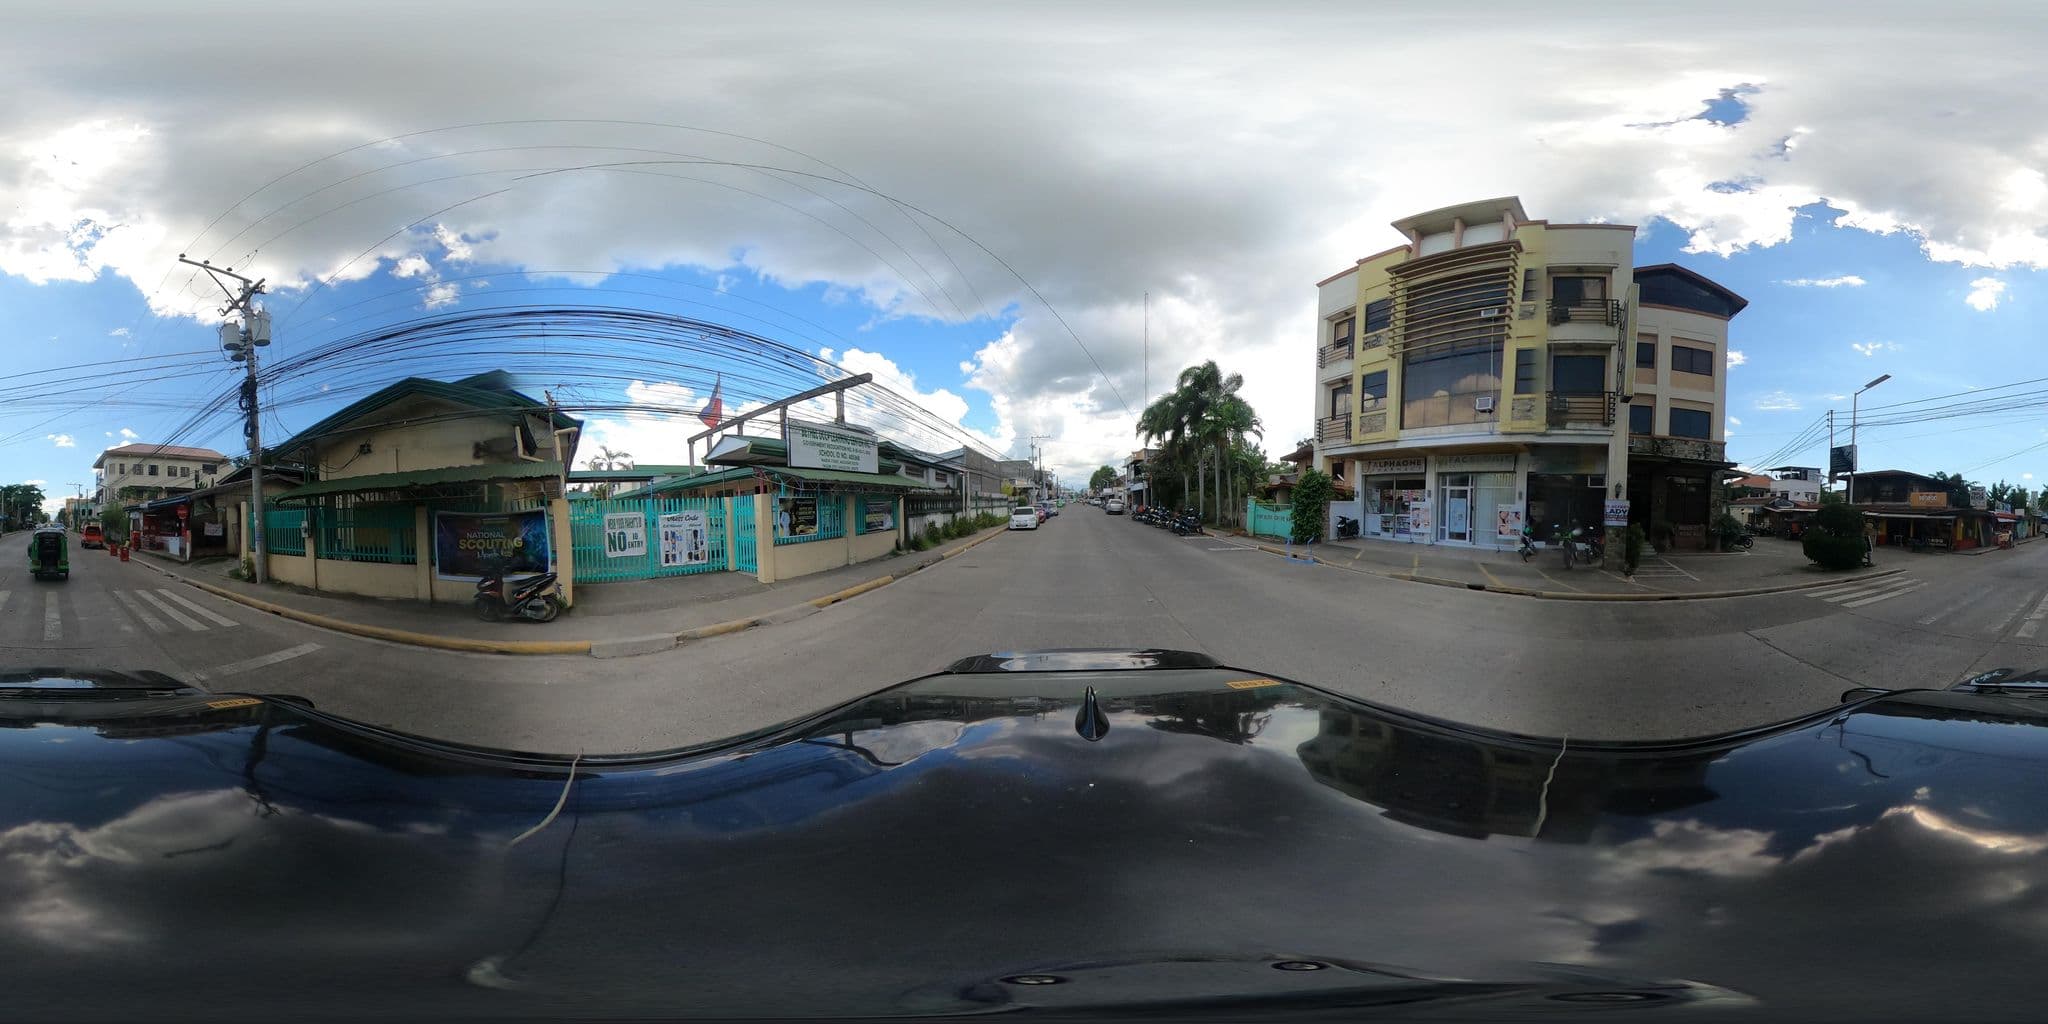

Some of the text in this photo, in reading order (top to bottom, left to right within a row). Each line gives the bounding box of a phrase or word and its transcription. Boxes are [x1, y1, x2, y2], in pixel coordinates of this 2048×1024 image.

[459, 537, 523, 550] SCOUTING
[607, 531, 627, 552] NO
[628, 540, 643, 549] ENTRY
